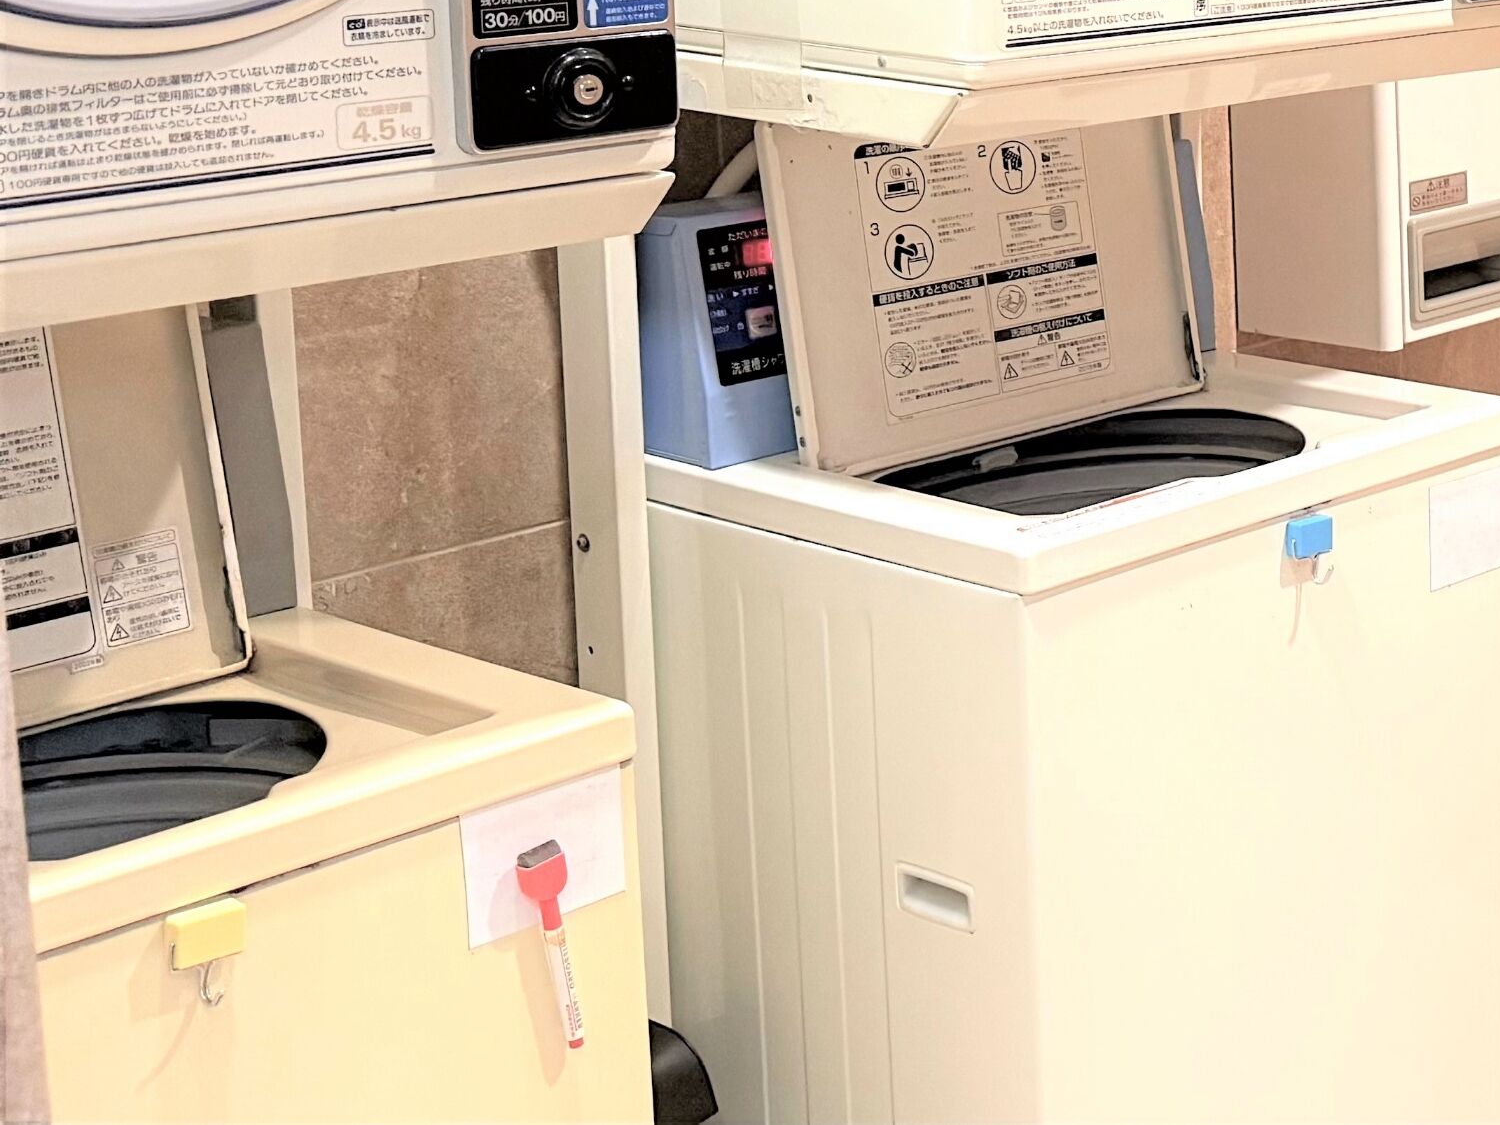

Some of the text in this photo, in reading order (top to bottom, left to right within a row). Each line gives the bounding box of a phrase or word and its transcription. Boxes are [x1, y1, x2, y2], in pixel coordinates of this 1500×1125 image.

[484, 8, 567, 30] 30分/100円
[352, 118, 422, 143] 4.5 kg
[977, 144, 987, 158] 2
[863, 161, 870, 175] 1
[870, 222, 880, 236] 3
